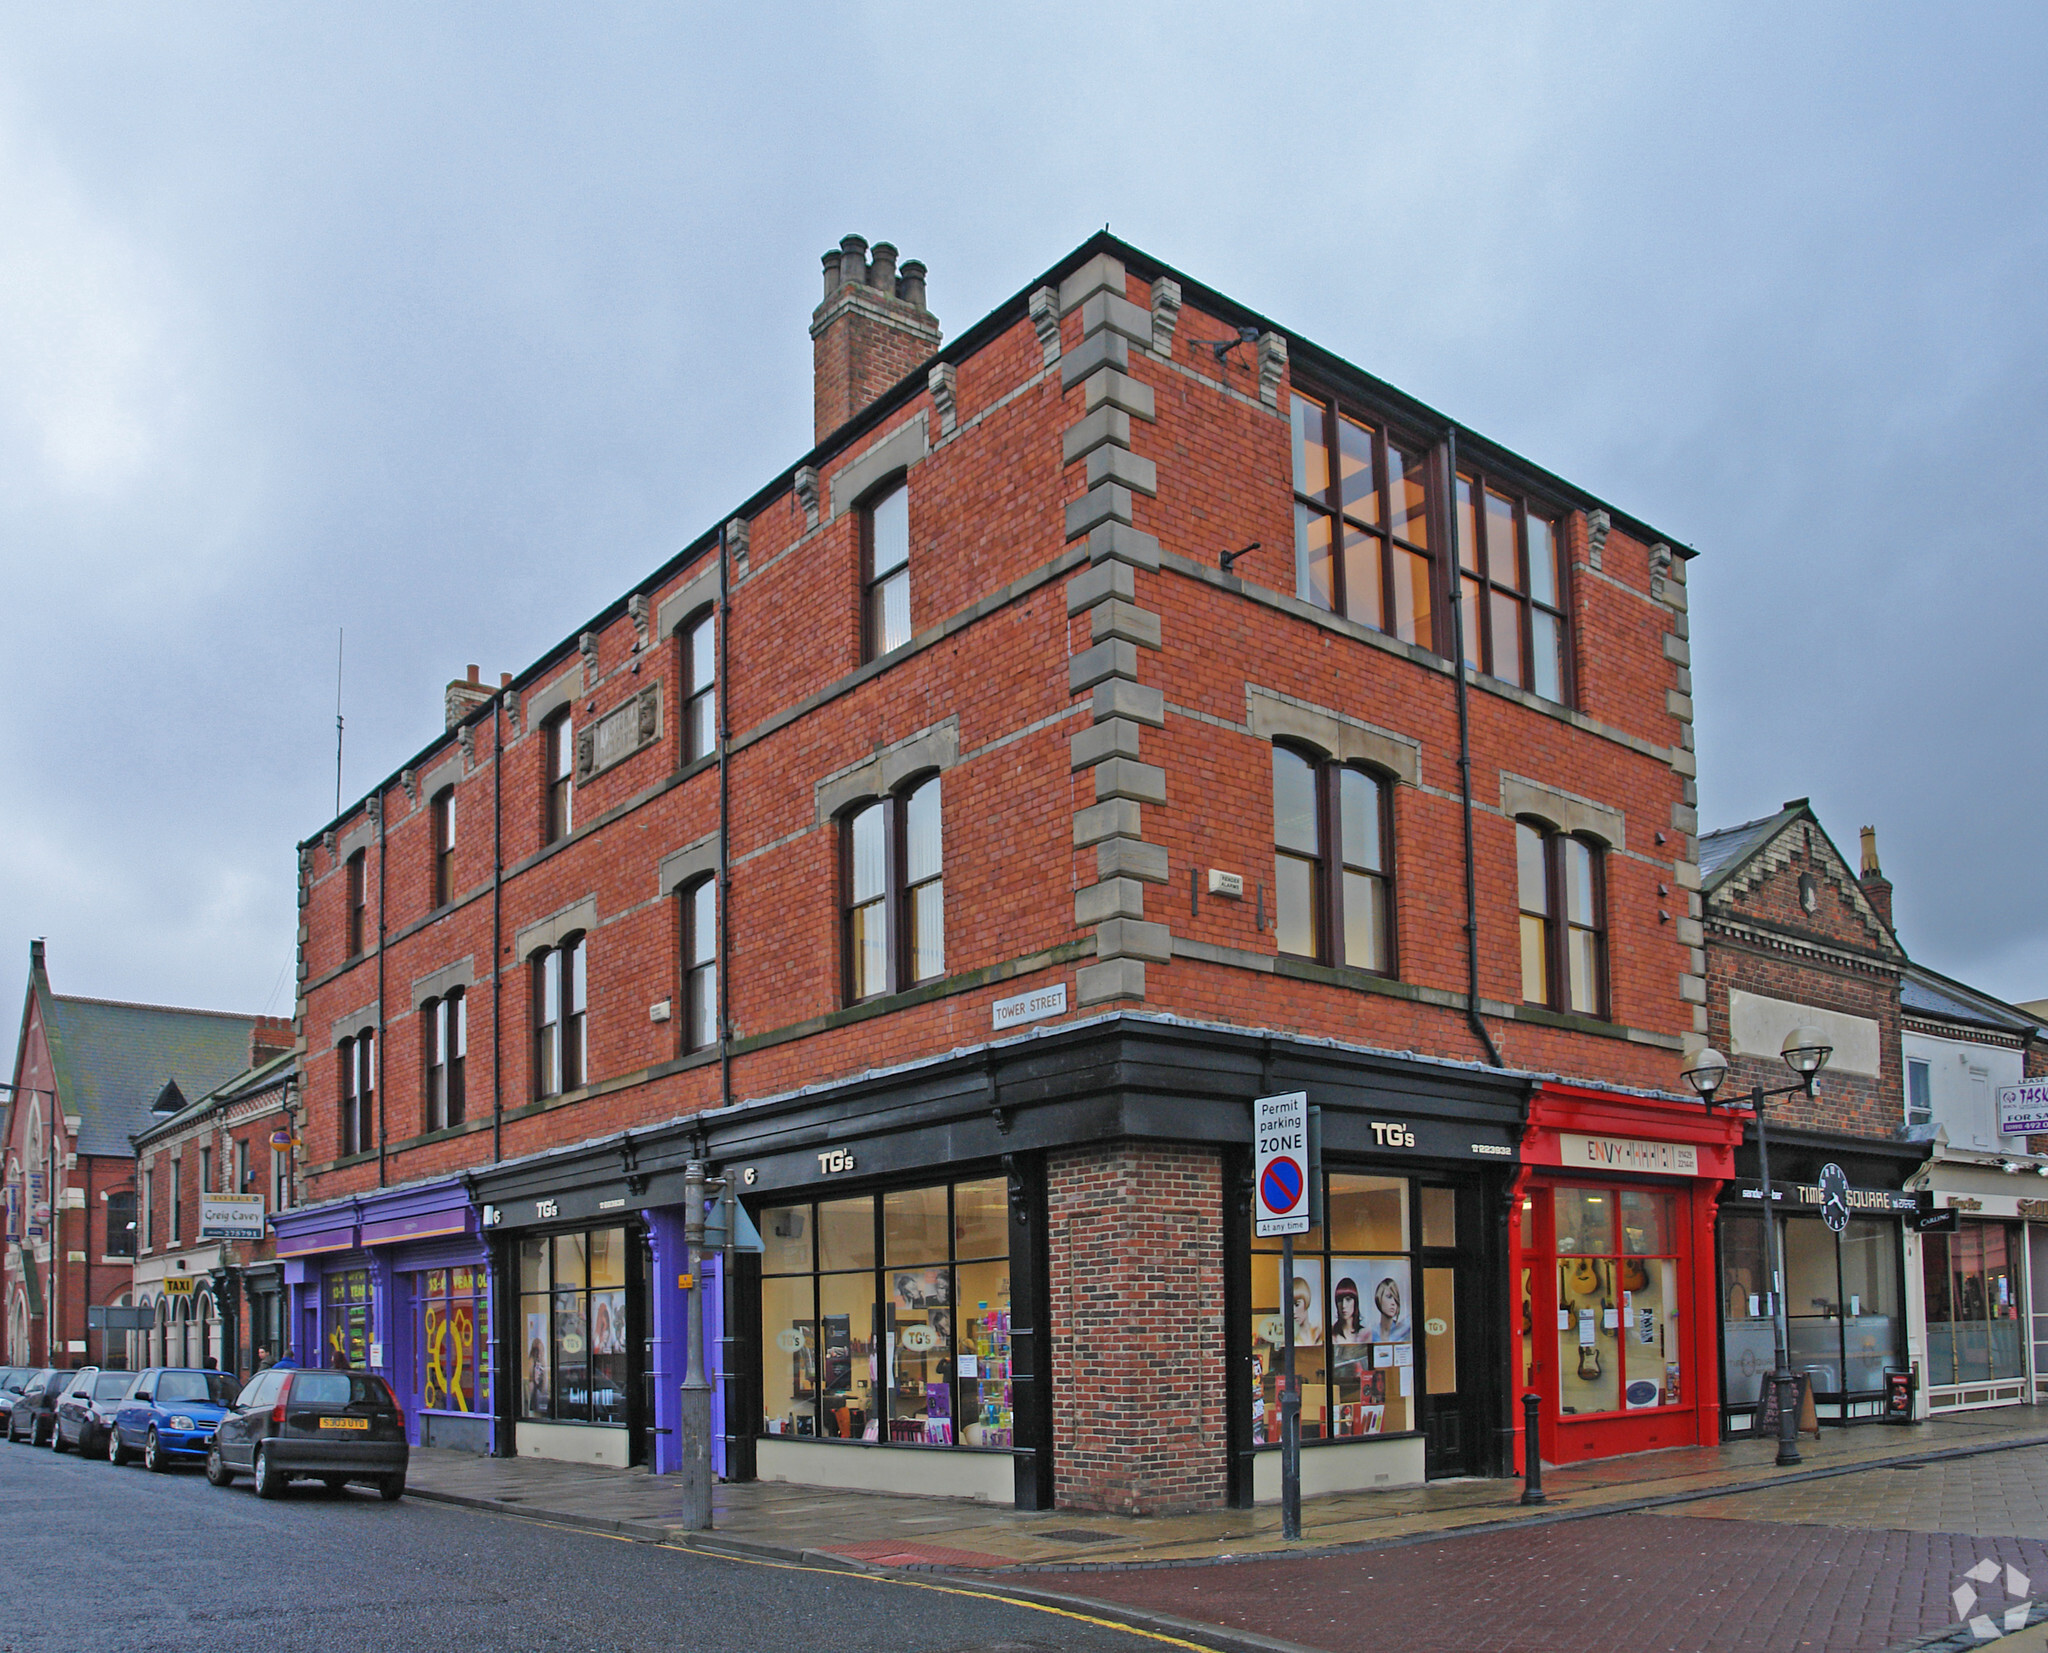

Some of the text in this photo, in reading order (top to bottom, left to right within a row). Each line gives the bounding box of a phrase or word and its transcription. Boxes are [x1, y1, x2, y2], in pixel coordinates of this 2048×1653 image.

[997, 993, 1062, 1020] TOWER STREET
[1262, 1099, 1298, 1115] Permit
[1260, 1116, 1301, 1133] parking
[1371, 1122, 1415, 1147] TG's
[1260, 1134, 1302, 1153] ZONE
[1588, 1140, 1622, 1163] ENVY
[818, 1147, 854, 1174] TG's
[1797, 1185, 1826, 1204] TIME
[1845, 1189, 1890, 1209] SQUARE
[231, 1210, 260, 1223] Cavey
[1262, 1220, 1303, 1232] At any time
[167, 1280, 190, 1291] TAXI
[453, 1274, 473, 1289] YEAR
[1428, 1322, 1444, 1332] TG's
[908, 1331, 931, 1345] TG's
